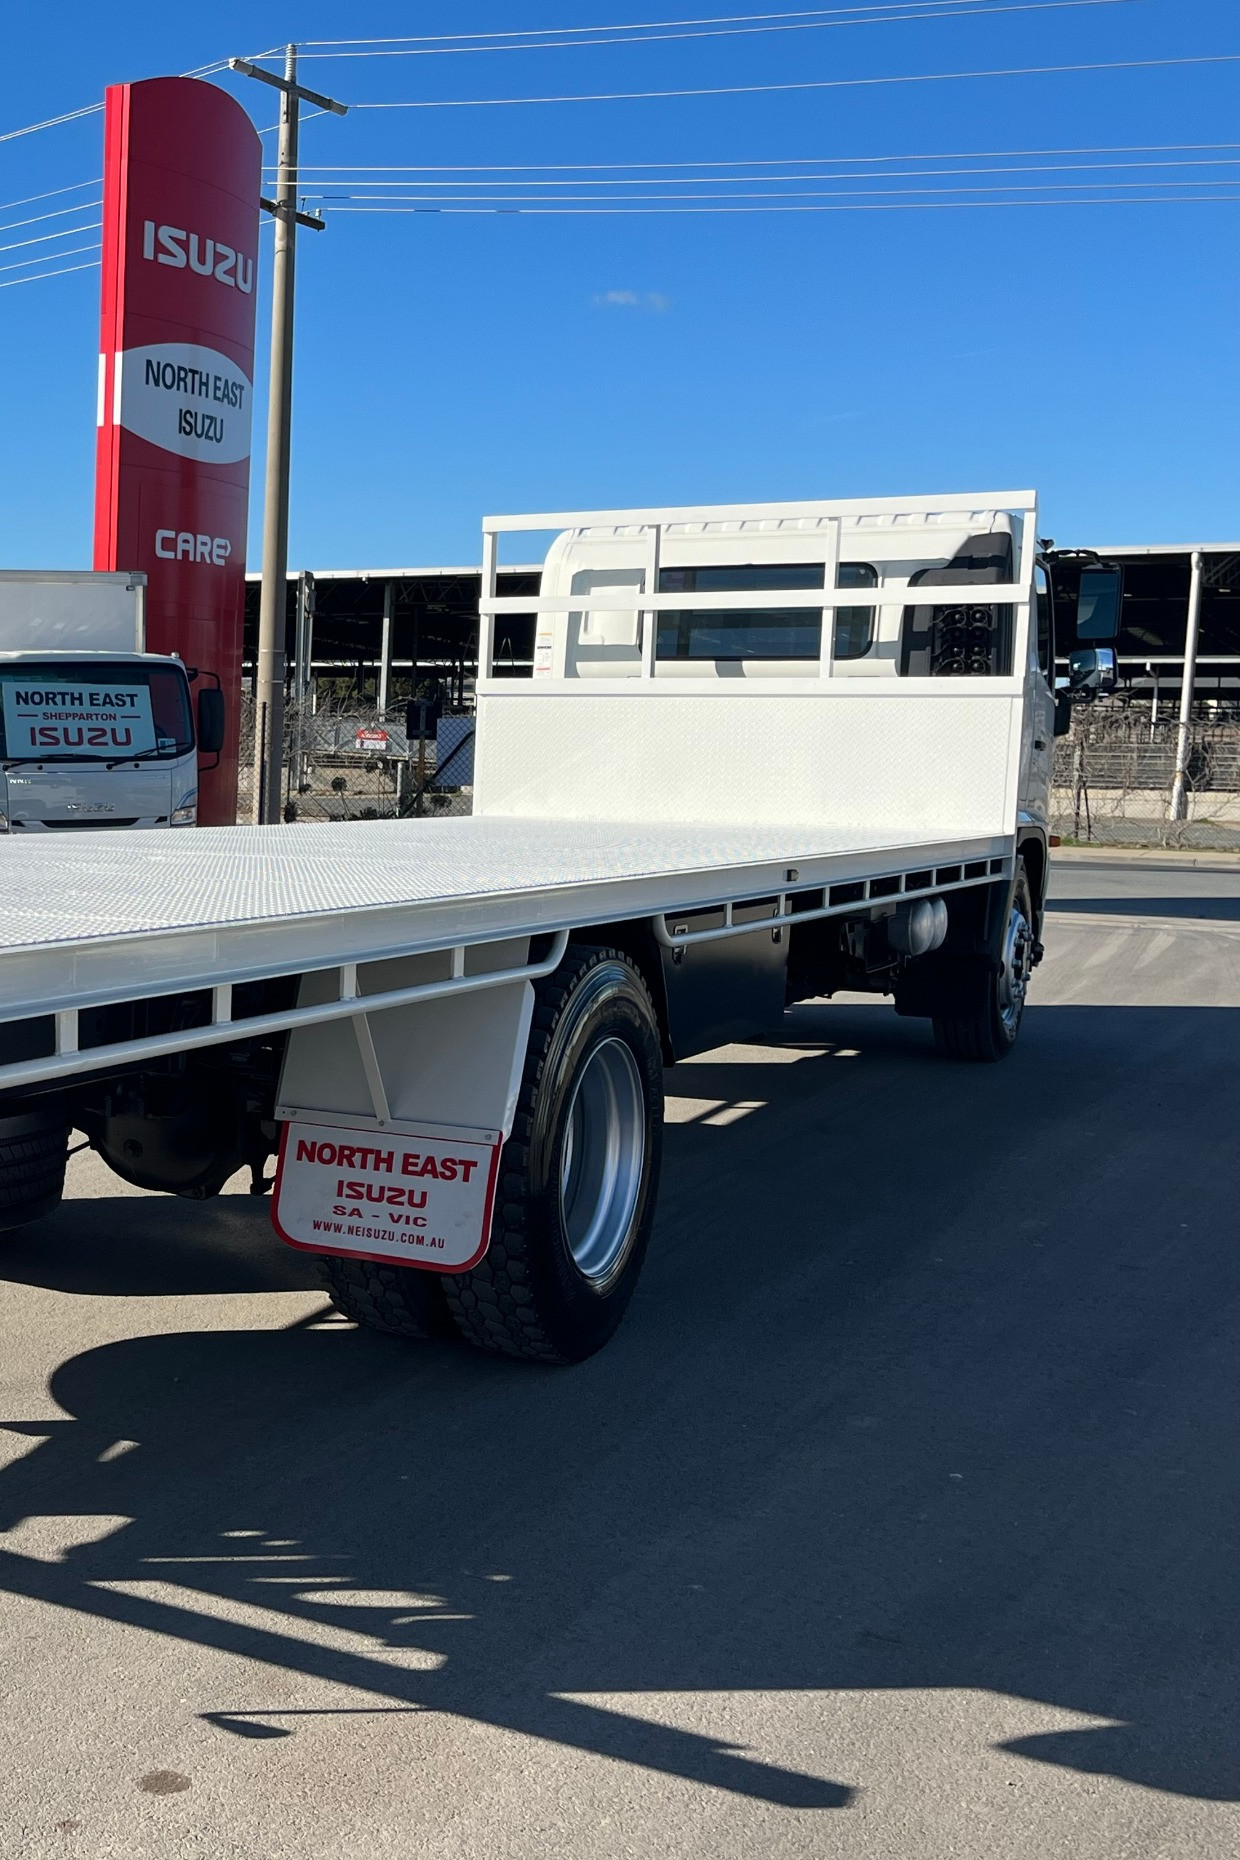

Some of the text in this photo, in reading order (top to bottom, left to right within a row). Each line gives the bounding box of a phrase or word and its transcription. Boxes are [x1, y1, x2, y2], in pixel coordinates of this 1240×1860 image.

[143, 220, 253, 294] ISUZU
[145, 359, 245, 410] NORTH EAST
[178, 408, 224, 444] ISUZU
[155, 529, 230, 567] CARE
[15, 691, 138, 708] NORTH EAST
[42, 711, 117, 722] SHEPPARTON
[30, 726, 132, 746] ISUZU
[296, 1140, 478, 1183] NORTH EAST
[336, 1180, 428, 1209] ISUZU
[333, 1205, 364, 1219] SA
[389, 1212, 428, 1228] VIC
[313, 1220, 445, 1249] WWW.NEISUZU.COM.AU
